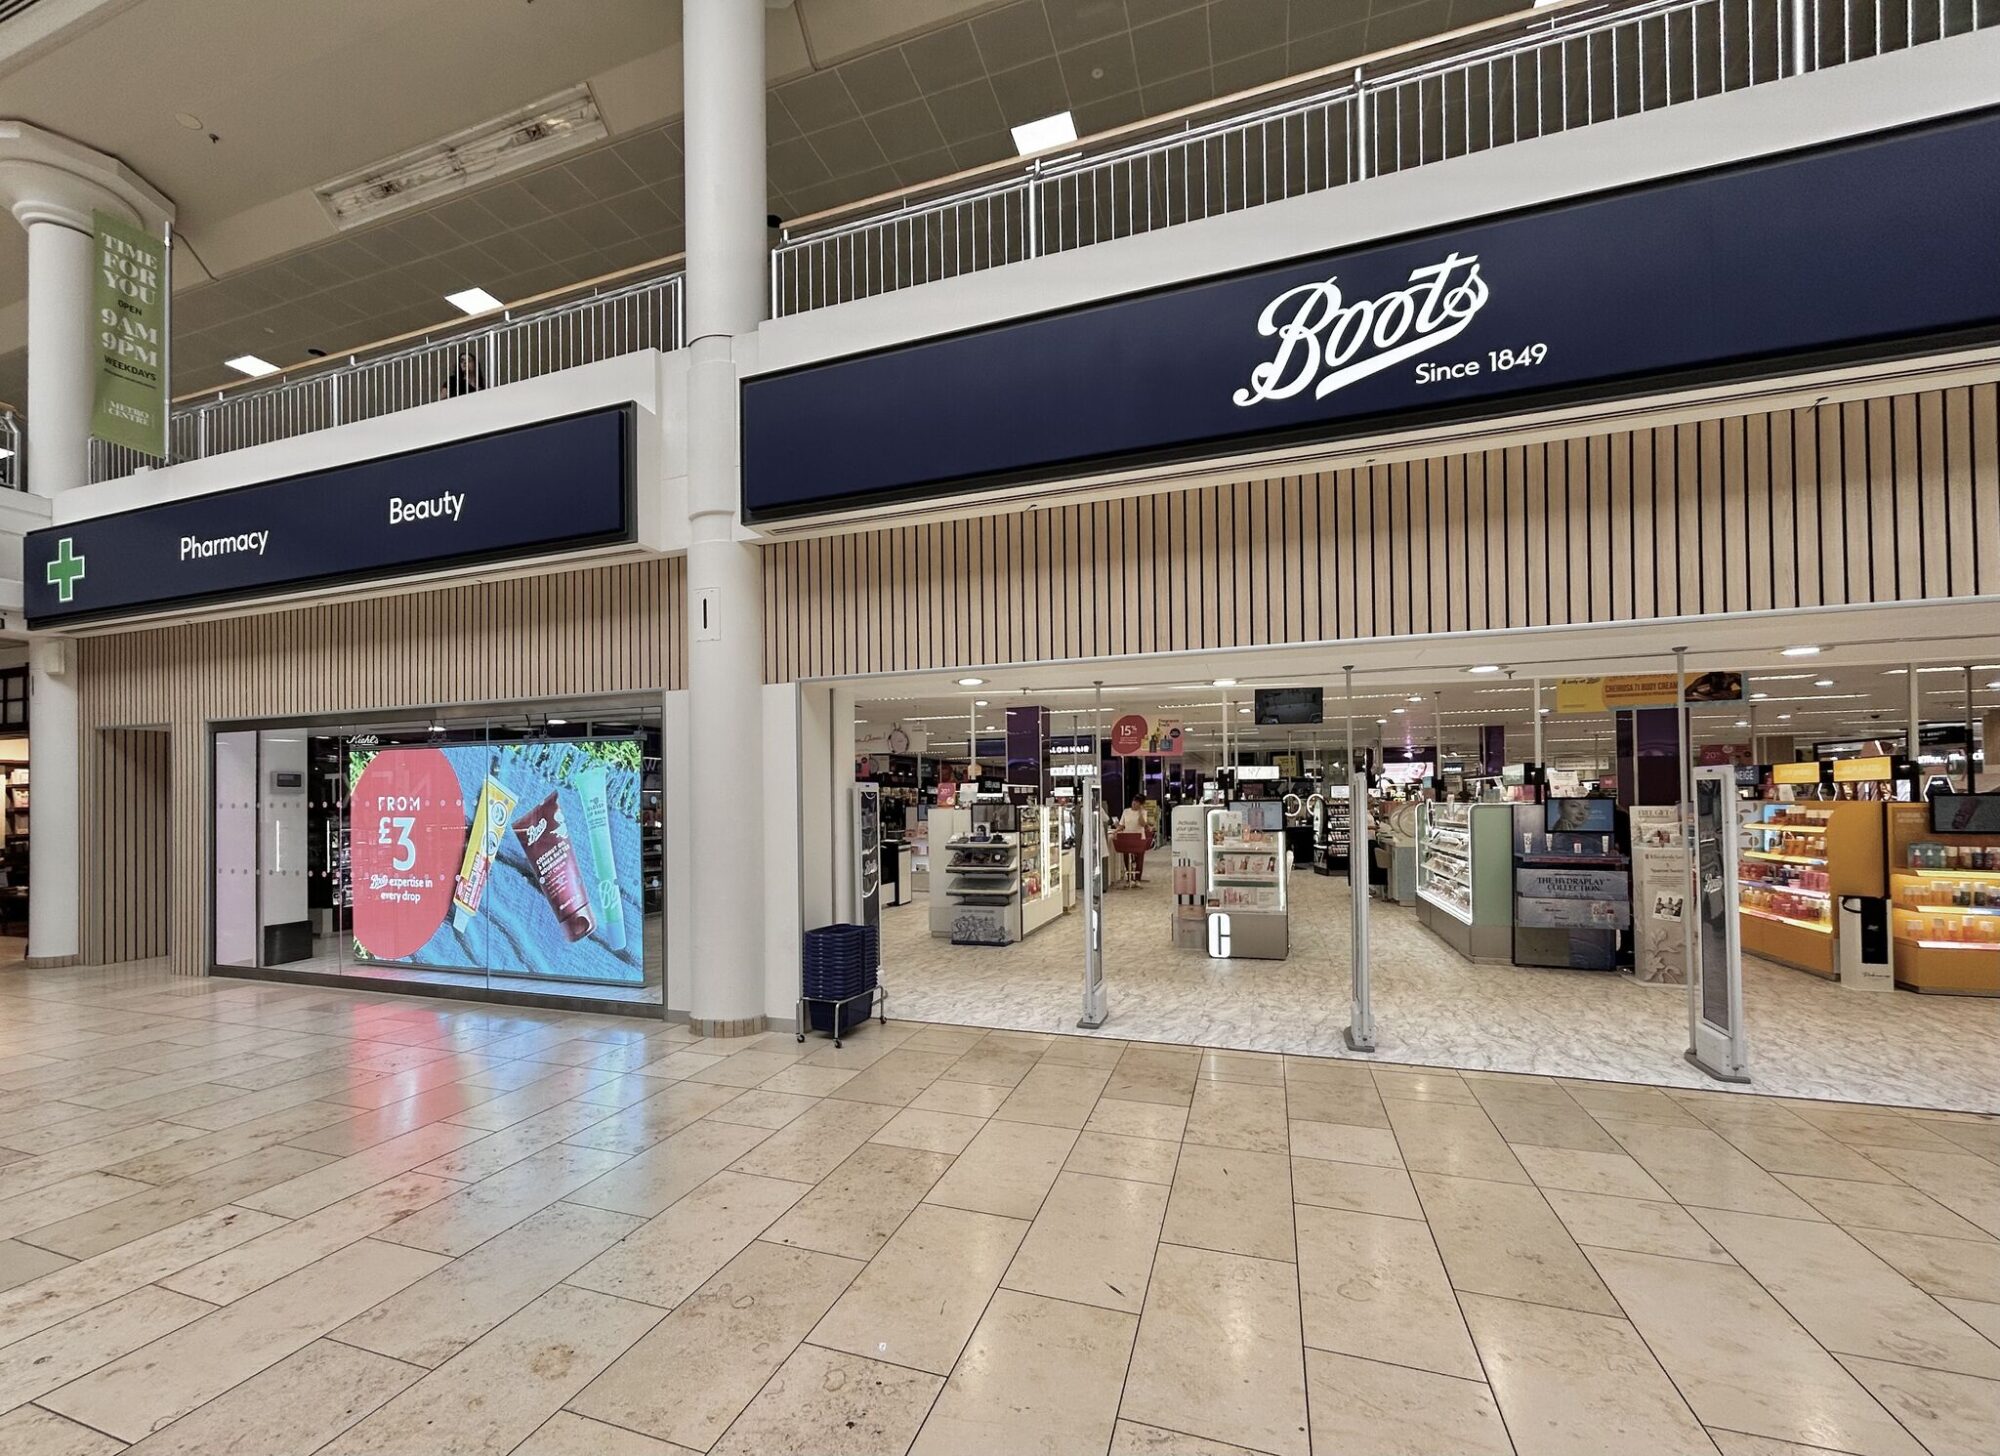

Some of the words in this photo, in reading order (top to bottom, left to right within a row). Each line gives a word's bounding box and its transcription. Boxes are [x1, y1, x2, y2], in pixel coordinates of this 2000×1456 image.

[101, 232, 157, 270] TIME
[102, 251, 156, 288] FOR
[102, 269, 156, 304] YOU
[118, 299, 142, 316] OPEN
[101, 308, 157, 345] 9AM
[1232, 252, 1489, 407] Boots
[101, 331, 157, 367] 9PM
[1415, 360, 1480, 384] Since
[1487, 343, 1548, 373] 1849
[104, 355, 157, 381] WEEKDAYS
[108, 408, 149, 426] CENTRE
[110, 400, 150, 418] METRO
[389, 491, 466, 525] Beauty
[180, 530, 269, 561] Pharmacy
[378, 797, 420, 811] FROM
[378, 816, 416, 871] £3
[369, 874, 388, 889] Boots
[389, 877, 424, 889] expertise
[425, 878, 433, 888] in
[380, 892, 402, 902] every
[402, 890, 421, 904] drop
